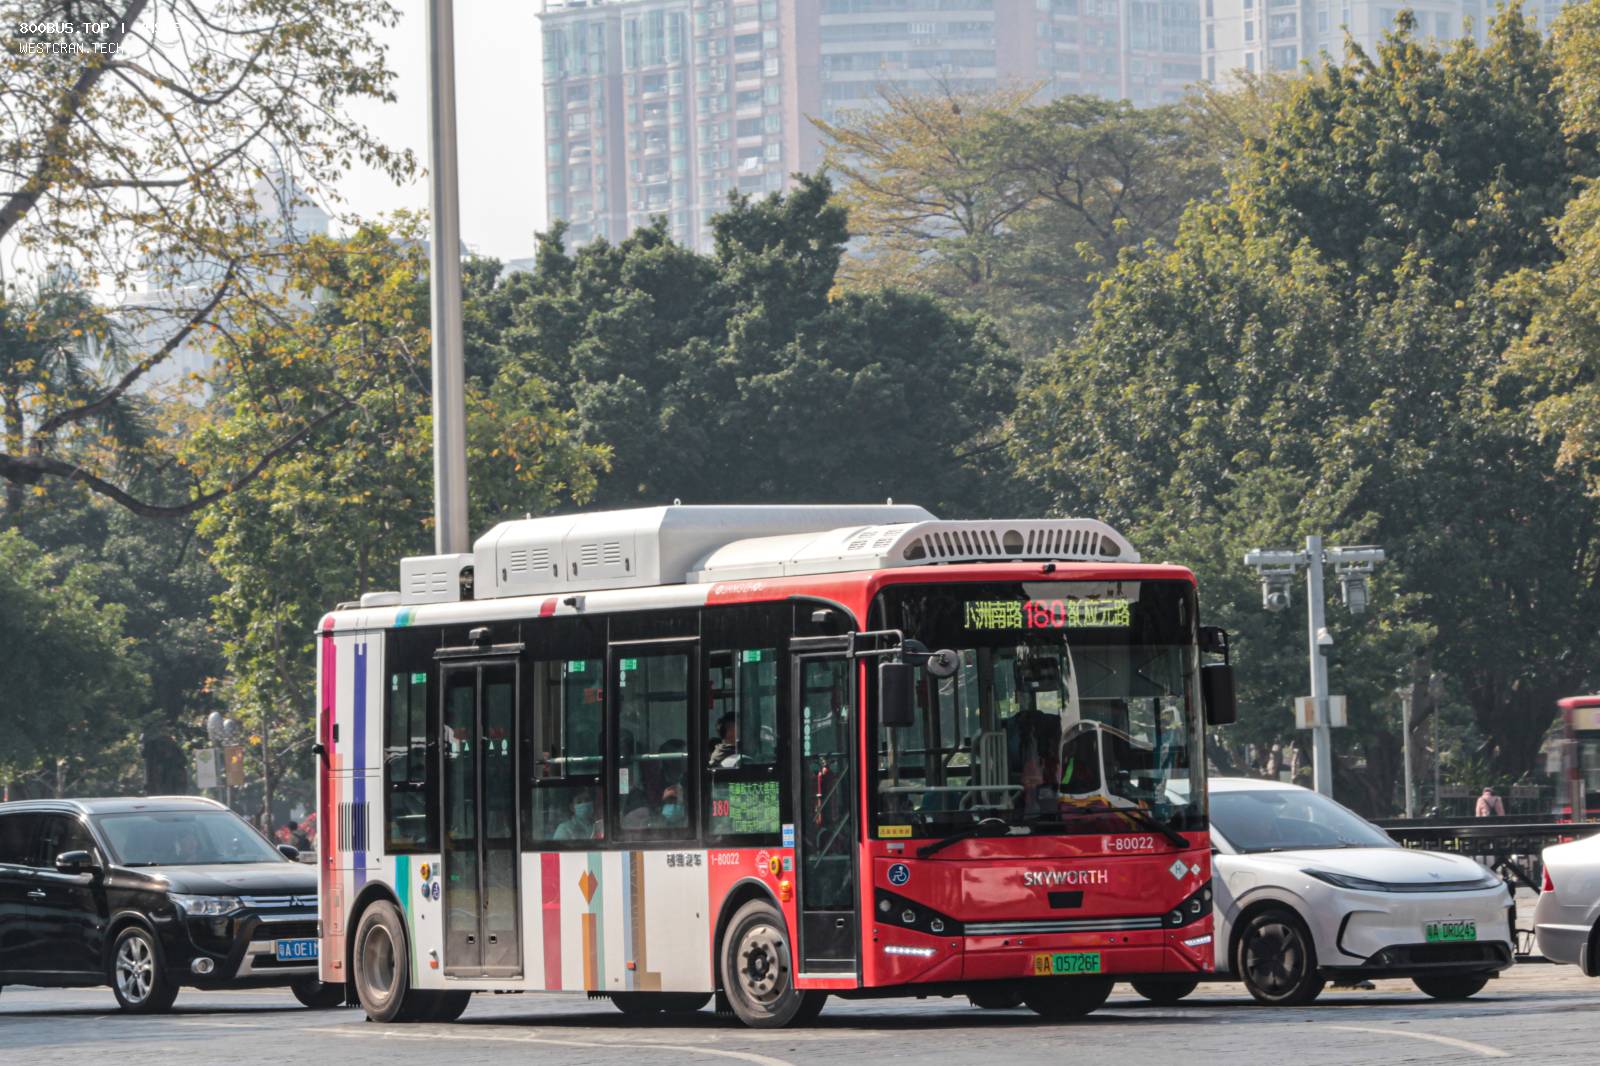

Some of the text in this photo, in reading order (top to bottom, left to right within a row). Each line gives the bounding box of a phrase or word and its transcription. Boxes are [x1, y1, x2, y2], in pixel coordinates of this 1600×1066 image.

[1023, 600, 1067, 629] 180
[712, 800, 729, 816] 180
[1103, 837, 1153, 851] 1-80022
[1023, 869, 1108, 886] SKYWORTH
[1055, 954, 1099, 972] 05726F
